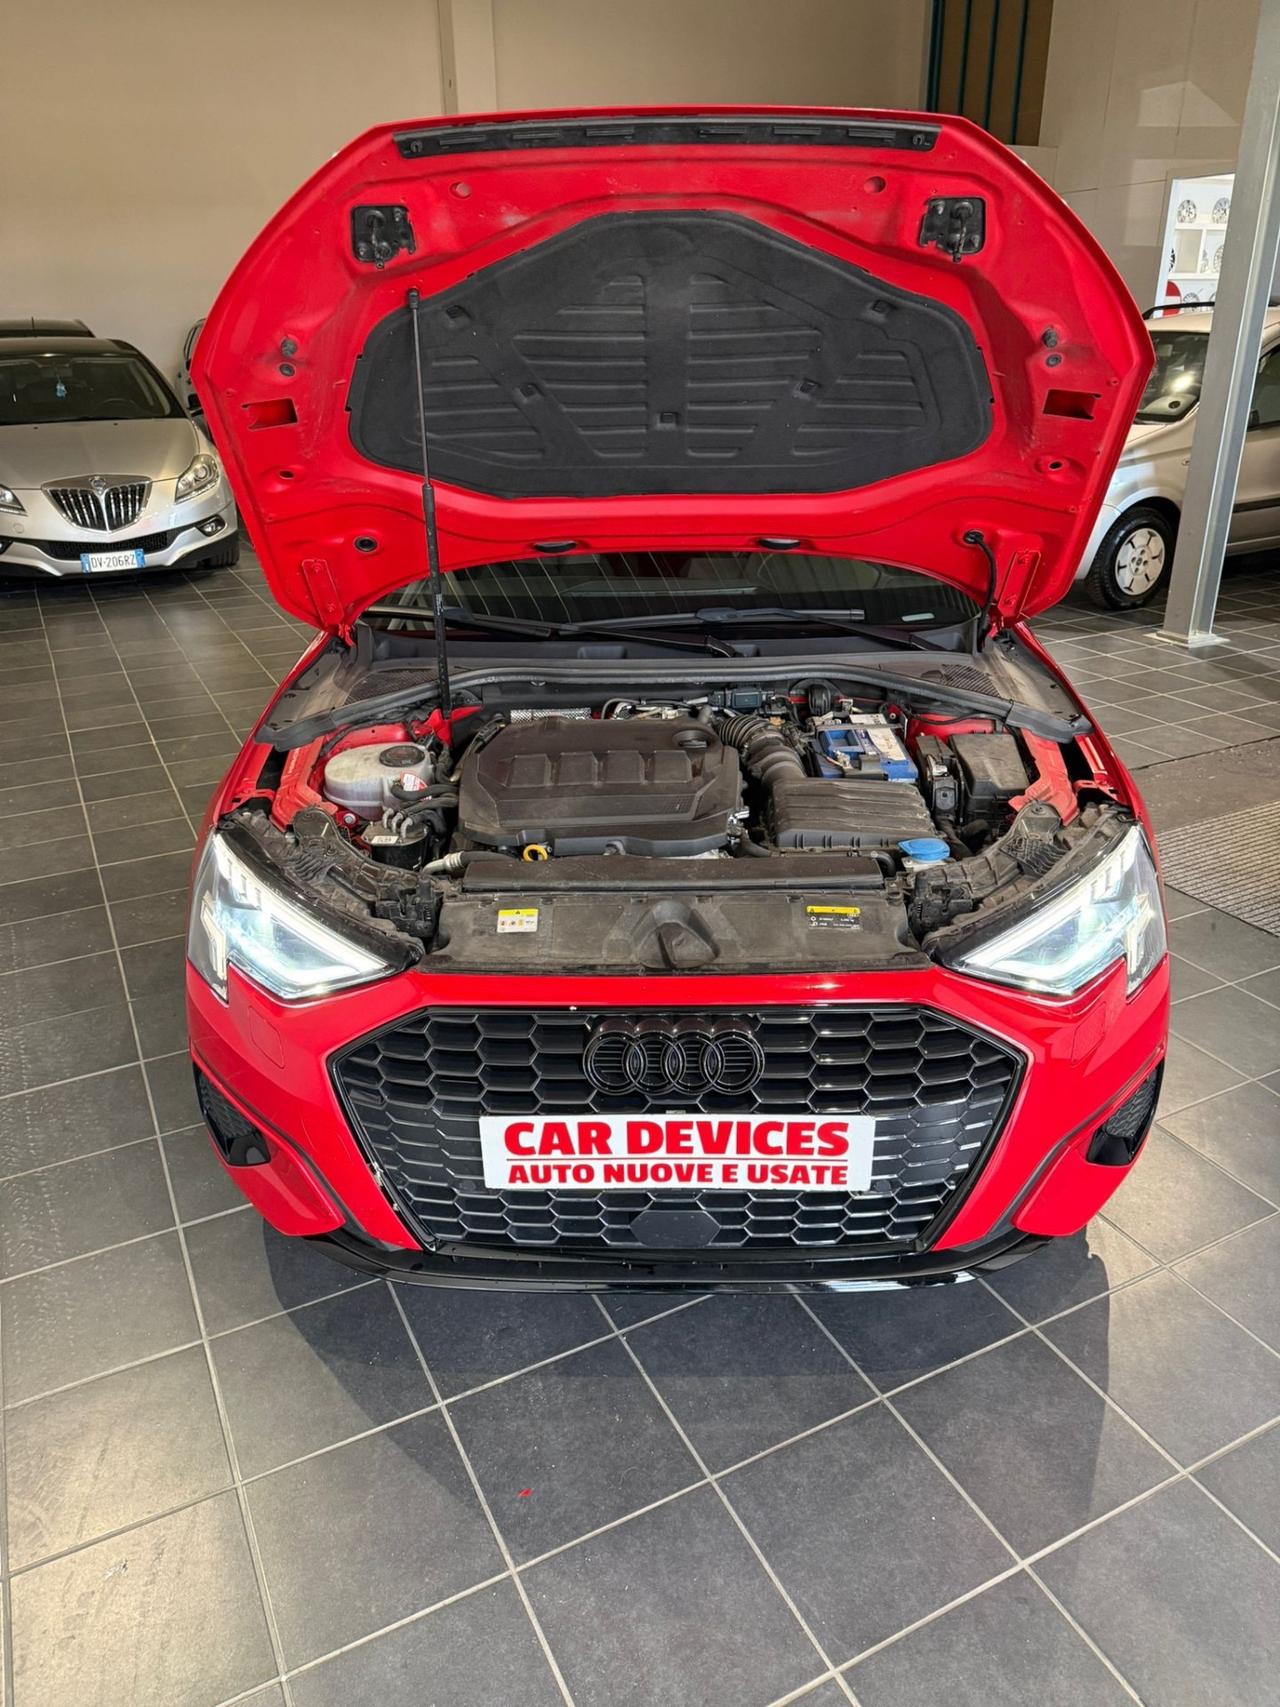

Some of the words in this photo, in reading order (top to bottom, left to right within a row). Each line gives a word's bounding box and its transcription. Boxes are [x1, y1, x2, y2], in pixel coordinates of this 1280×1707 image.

[504, 1121, 612, 1156] CAR
[626, 1120, 849, 1157] DEVICES
[509, 1164, 595, 1184] AUTO
[603, 1163, 713, 1183] NUOVE
[721, 1163, 738, 1183] E
[747, 1164, 848, 1185] USATE
